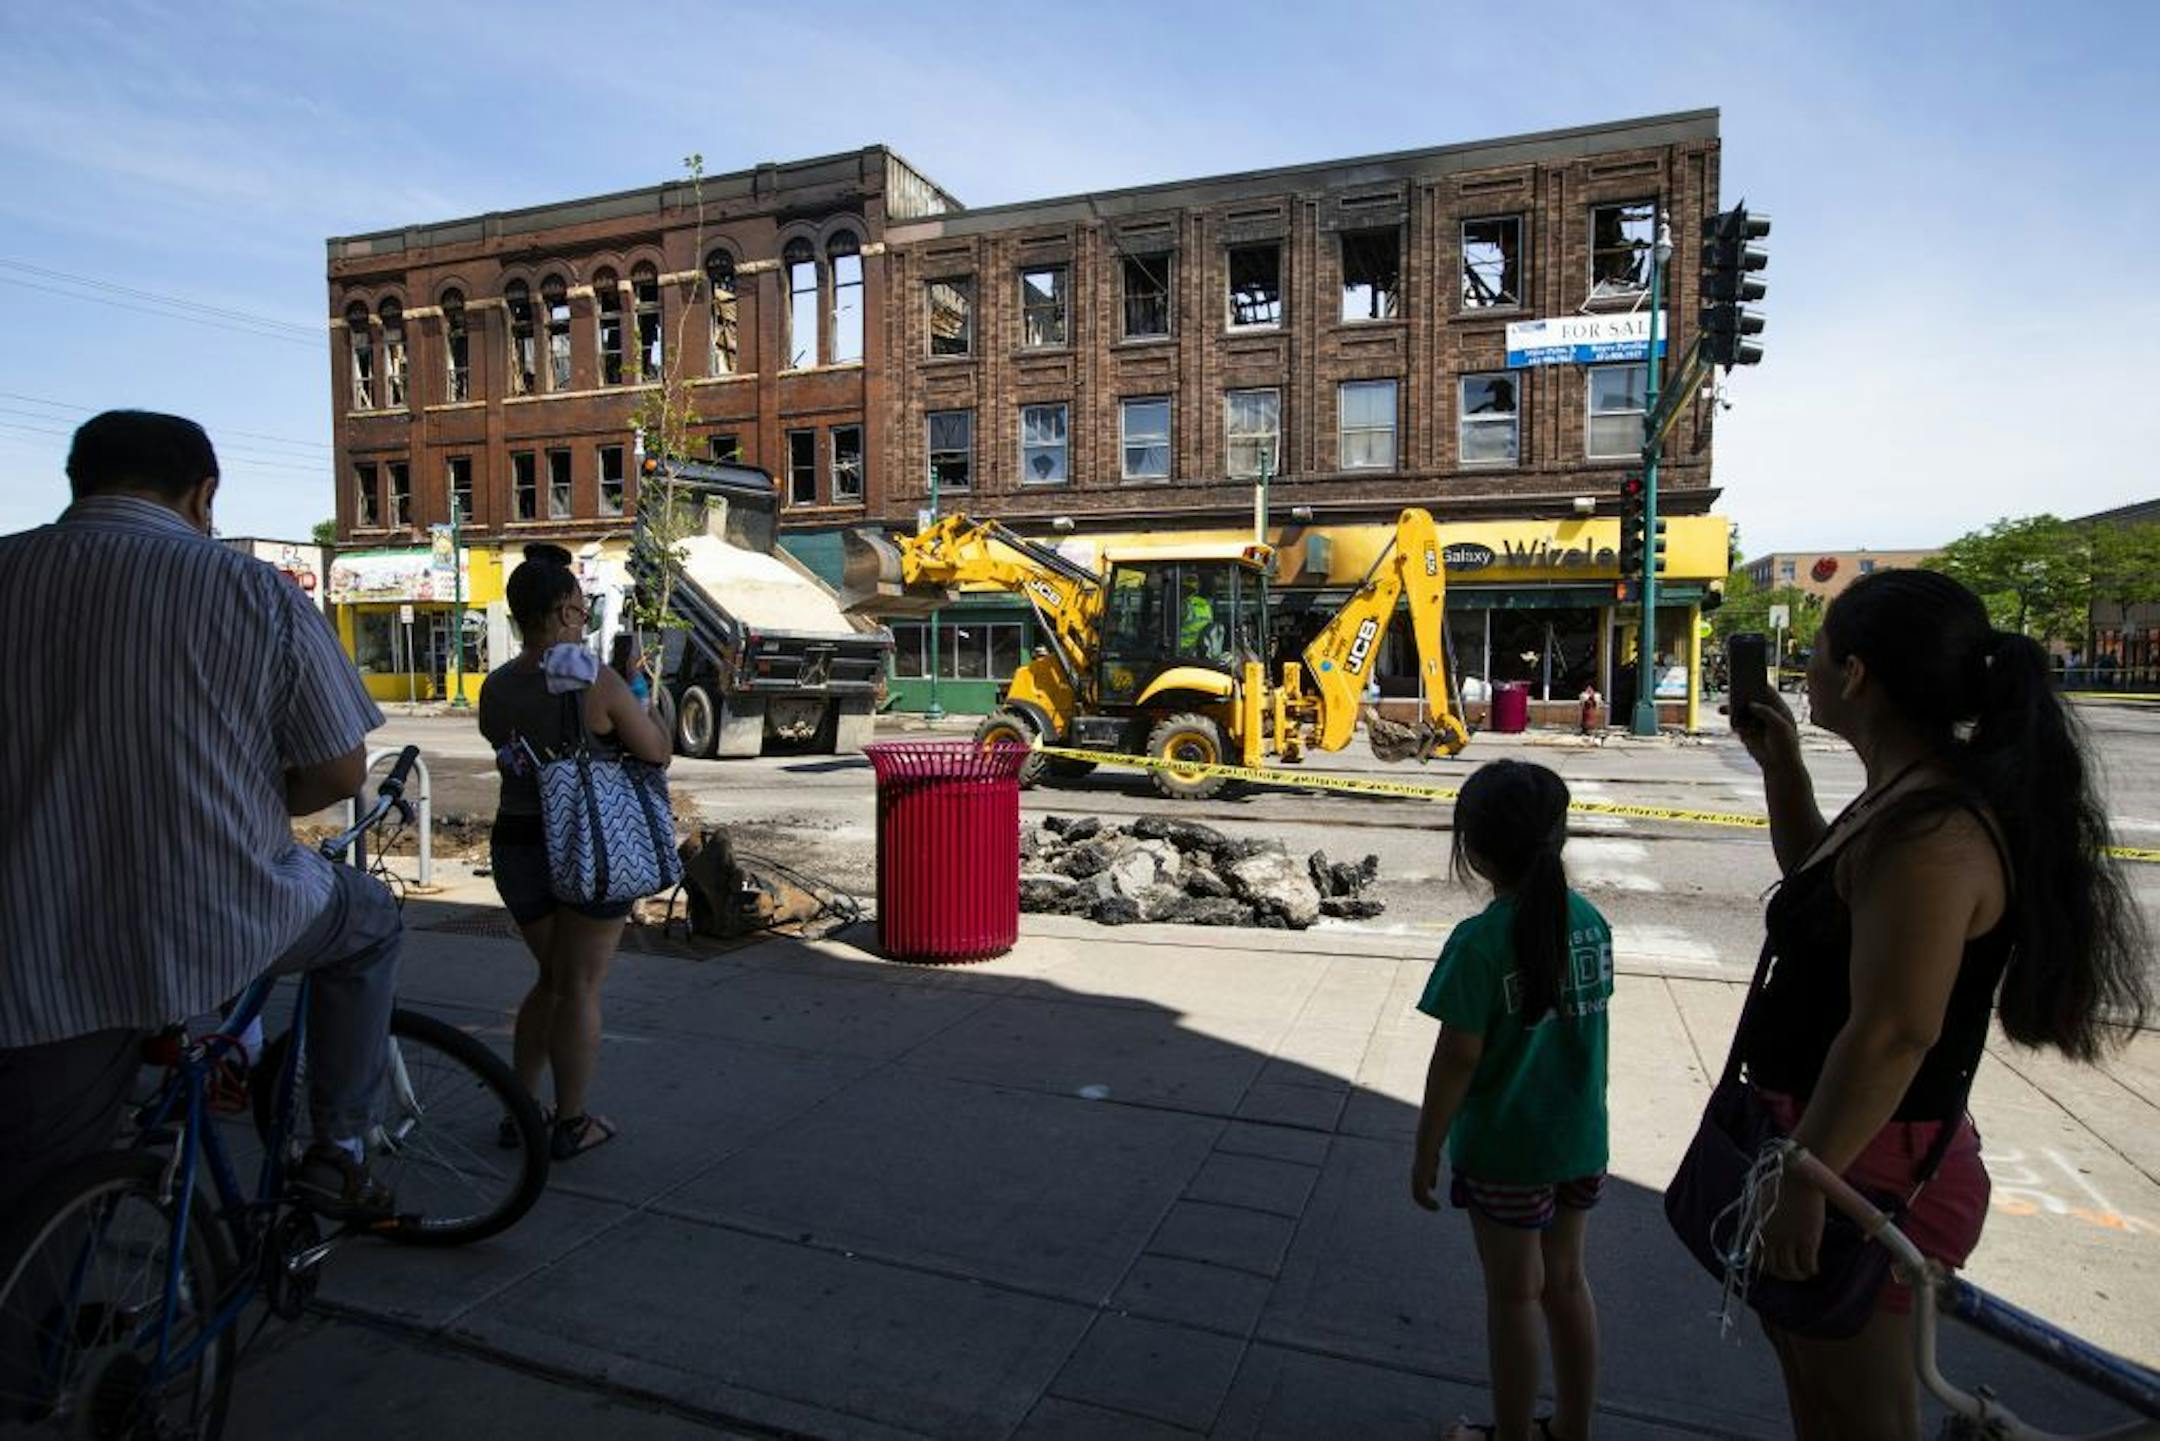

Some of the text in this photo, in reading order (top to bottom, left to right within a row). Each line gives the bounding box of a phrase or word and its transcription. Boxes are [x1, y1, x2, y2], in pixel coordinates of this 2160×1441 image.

[1562, 323, 1600, 338] FOR
[1609, 320, 1648, 336] SAL
[1444, 548, 1491, 565] Galaxy
[1503, 536, 1621, 567] Wirele
[1029, 579, 1062, 606] JCB
[1345, 618, 1378, 675] JCB
